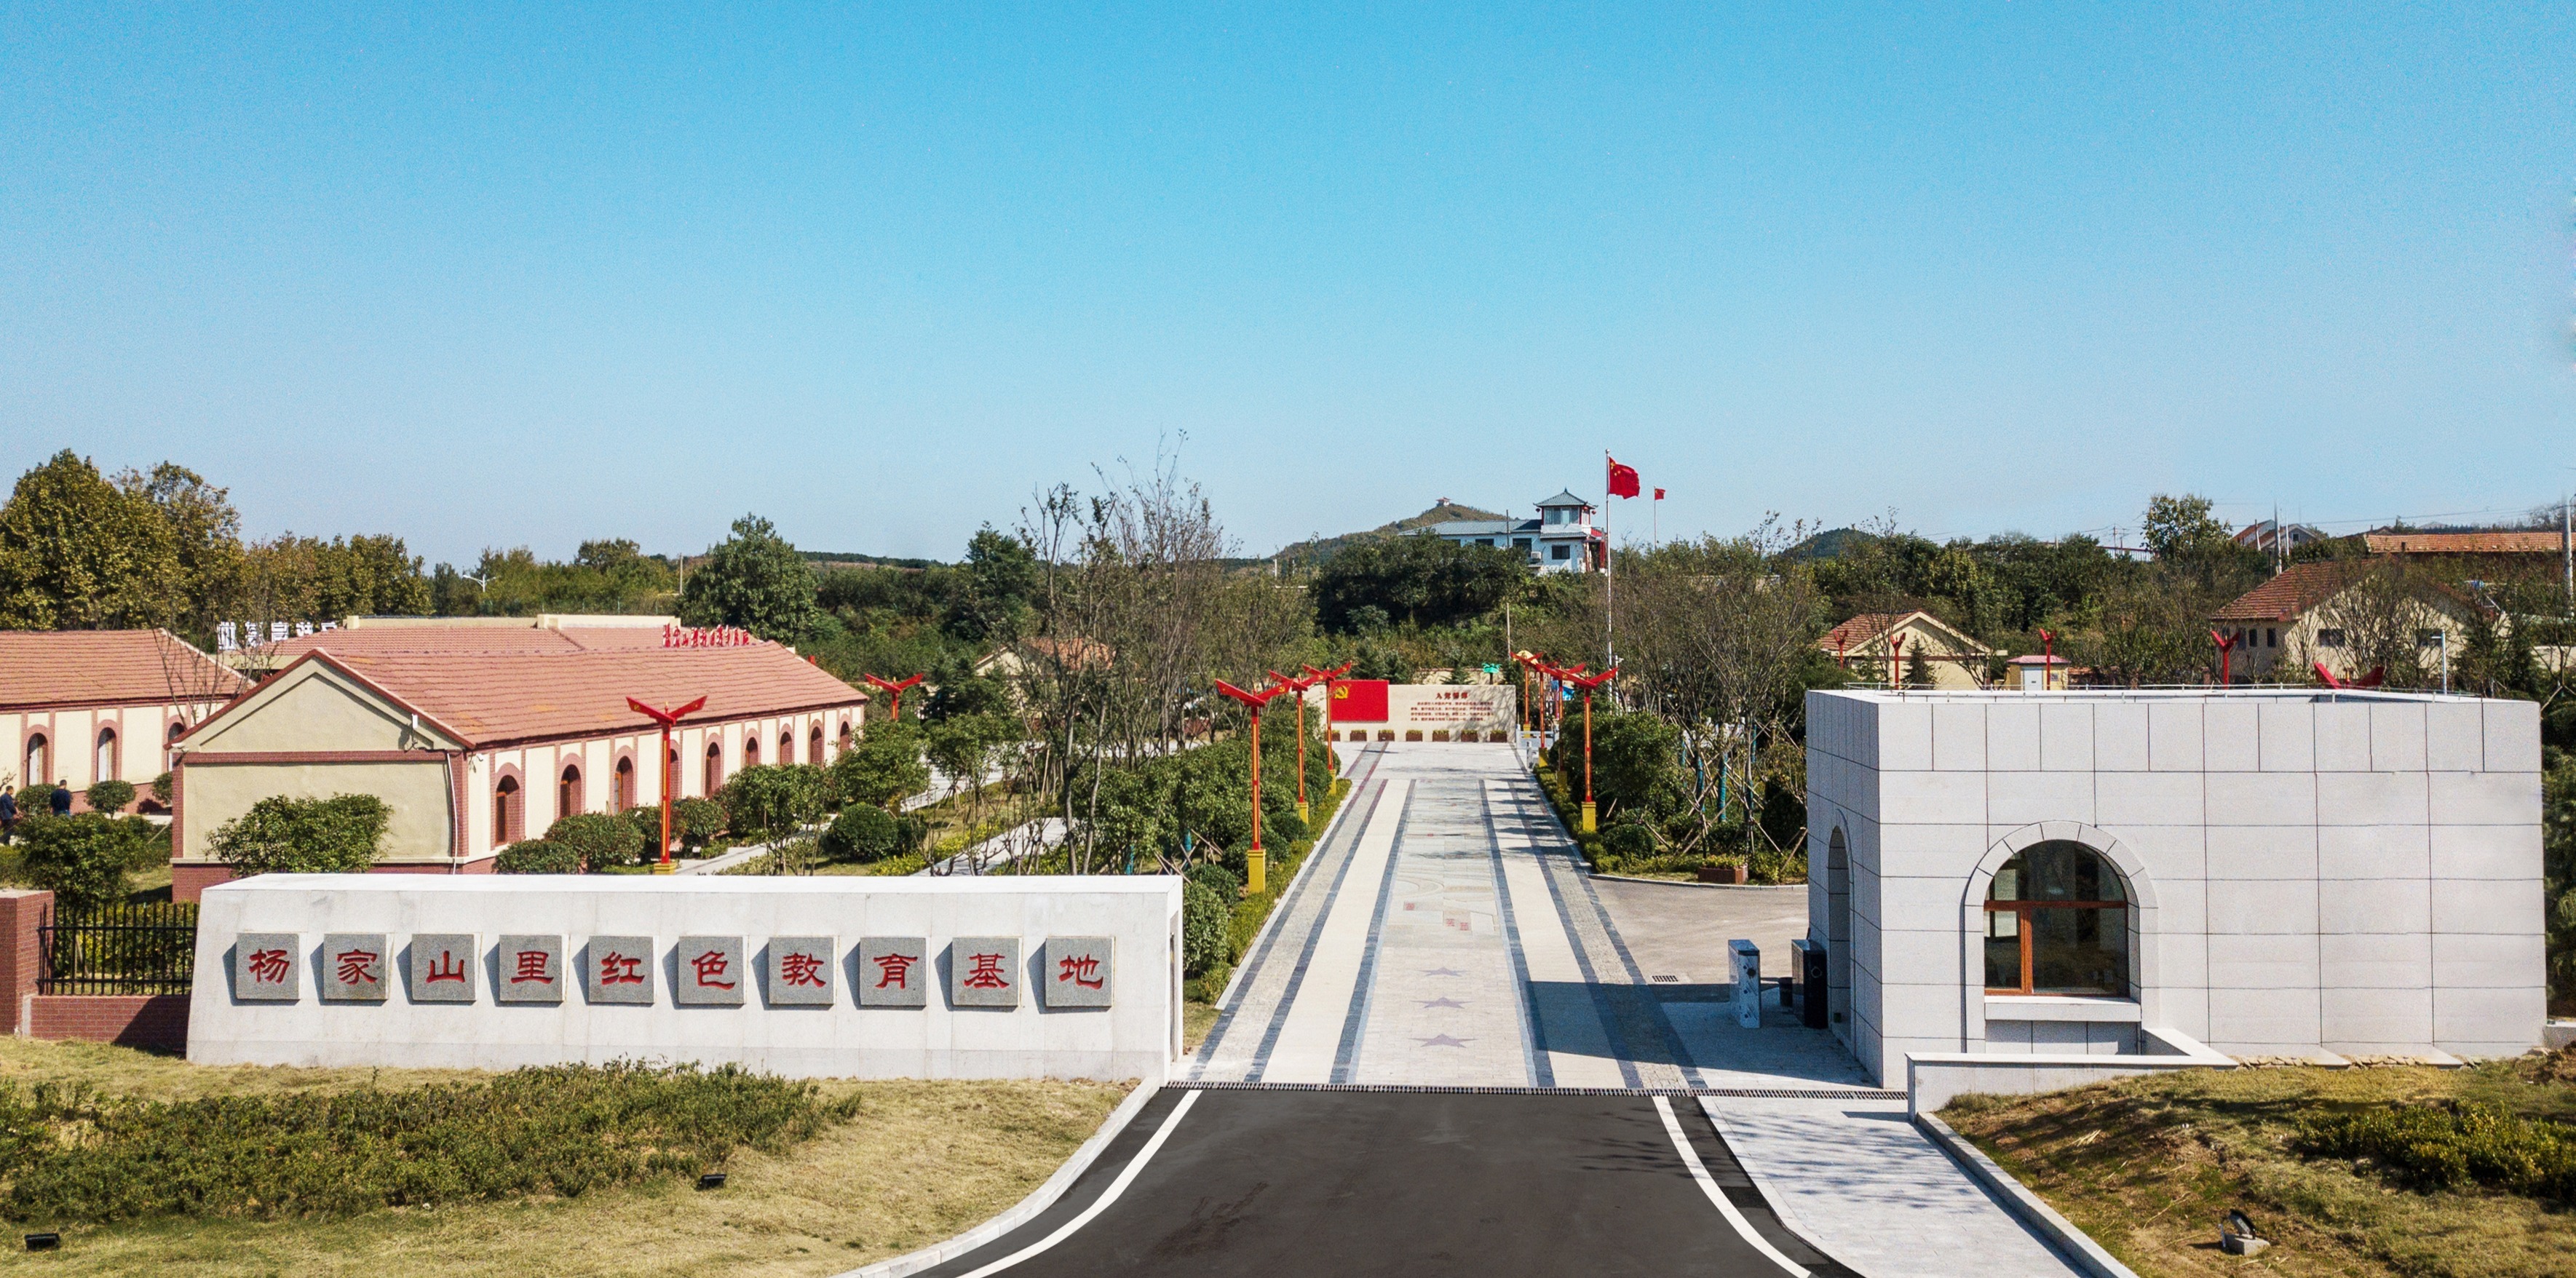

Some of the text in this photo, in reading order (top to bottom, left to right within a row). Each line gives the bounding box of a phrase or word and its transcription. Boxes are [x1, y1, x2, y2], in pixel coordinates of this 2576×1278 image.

[249, 949, 1103, 991] 杨家山里红色教育基地
